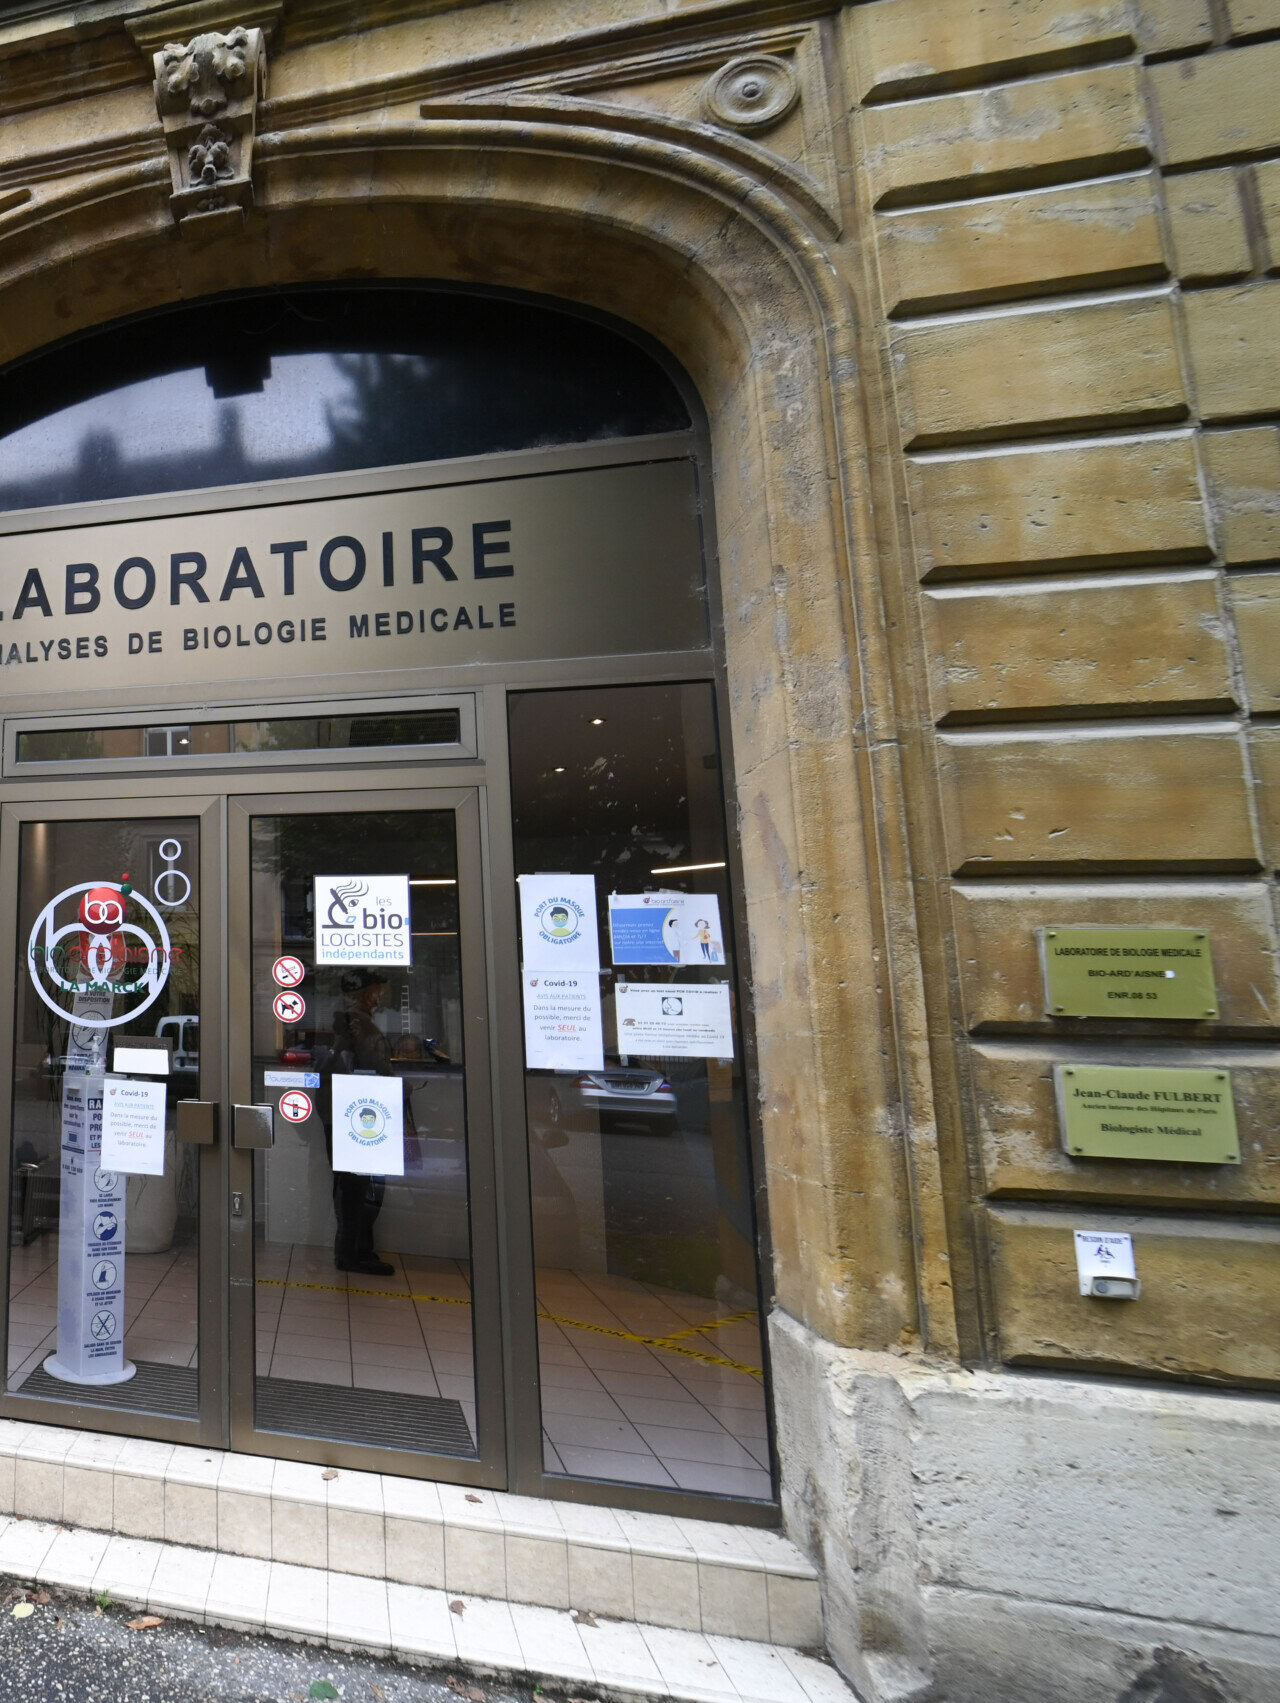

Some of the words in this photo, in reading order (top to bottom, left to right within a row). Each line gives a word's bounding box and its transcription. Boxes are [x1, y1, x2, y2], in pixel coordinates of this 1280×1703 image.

[127, 630, 163, 655] DE
[182, 617, 328, 650] BIOLOGIE
[349, 602, 517, 639] MEDICALE
[375, 896, 392, 907] les
[534, 900, 548, 917] PORT
[548, 896, 559, 904] DU
[560, 897, 585, 917] MASQUE
[321, 933, 404, 947] LOGISTES
[538, 930, 582, 945] OBLIGATOIRE
[321, 947, 404, 960] indépendants
[1054, 947, 1108, 956] LABORATOIRE
[1110, 948, 1120, 956] DE
[1122, 948, 1159, 957] BIOLOGIE
[1161, 948, 1202, 957] MEDICALE
[60, 981, 80, 993] LA
[85, 981, 145, 994] MARCK
[543, 979, 578, 987] Covid-19
[557, 1024, 577, 1032] SEUL
[120, 1089, 149, 1098] Covid-19
[1073, 1088, 1151, 1101] Jean-Claude
[1153, 1091, 1223, 1103] FULBERT
[344, 1101, 357, 1118] PORT
[357, 1097, 368, 1105] DU
[369, 1098, 392, 1120] MASQUE
[128, 1130, 144, 1138] SEUL
[1100, 1123, 1154, 1135] Biologiste
[1156, 1125, 1202, 1137] Médical
[348, 1131, 388, 1147] OBLIGATOIRE
